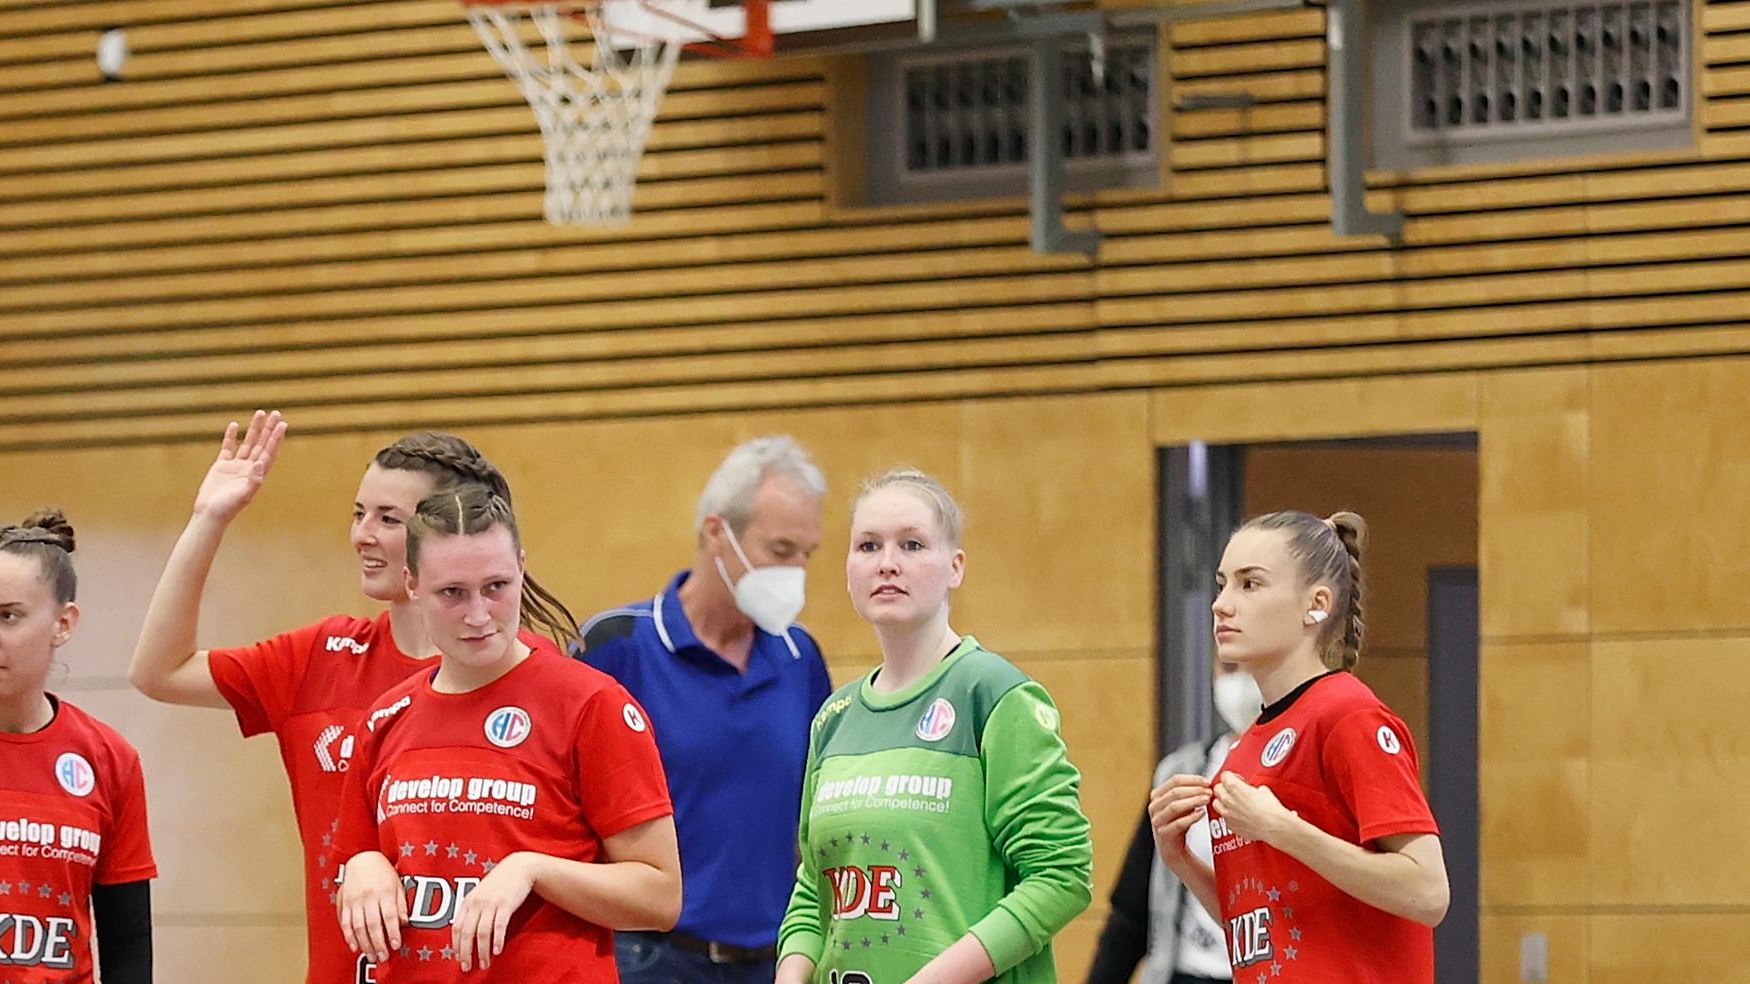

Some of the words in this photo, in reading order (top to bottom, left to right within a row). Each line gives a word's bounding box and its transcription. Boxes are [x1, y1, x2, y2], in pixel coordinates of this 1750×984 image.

[387, 776, 463, 802] develop
[468, 778, 537, 806] group
[817, 775, 882, 803] develop
[884, 774, 953, 799] group
[386, 800, 428, 815] Connect
[431, 800, 447, 813] for
[449, 800, 534, 820] Competence!
[866, 798, 951, 813] Competence!
[22, 843, 39, 857] for
[403, 875, 482, 929] DE
[1229, 907, 1274, 967] KDE
